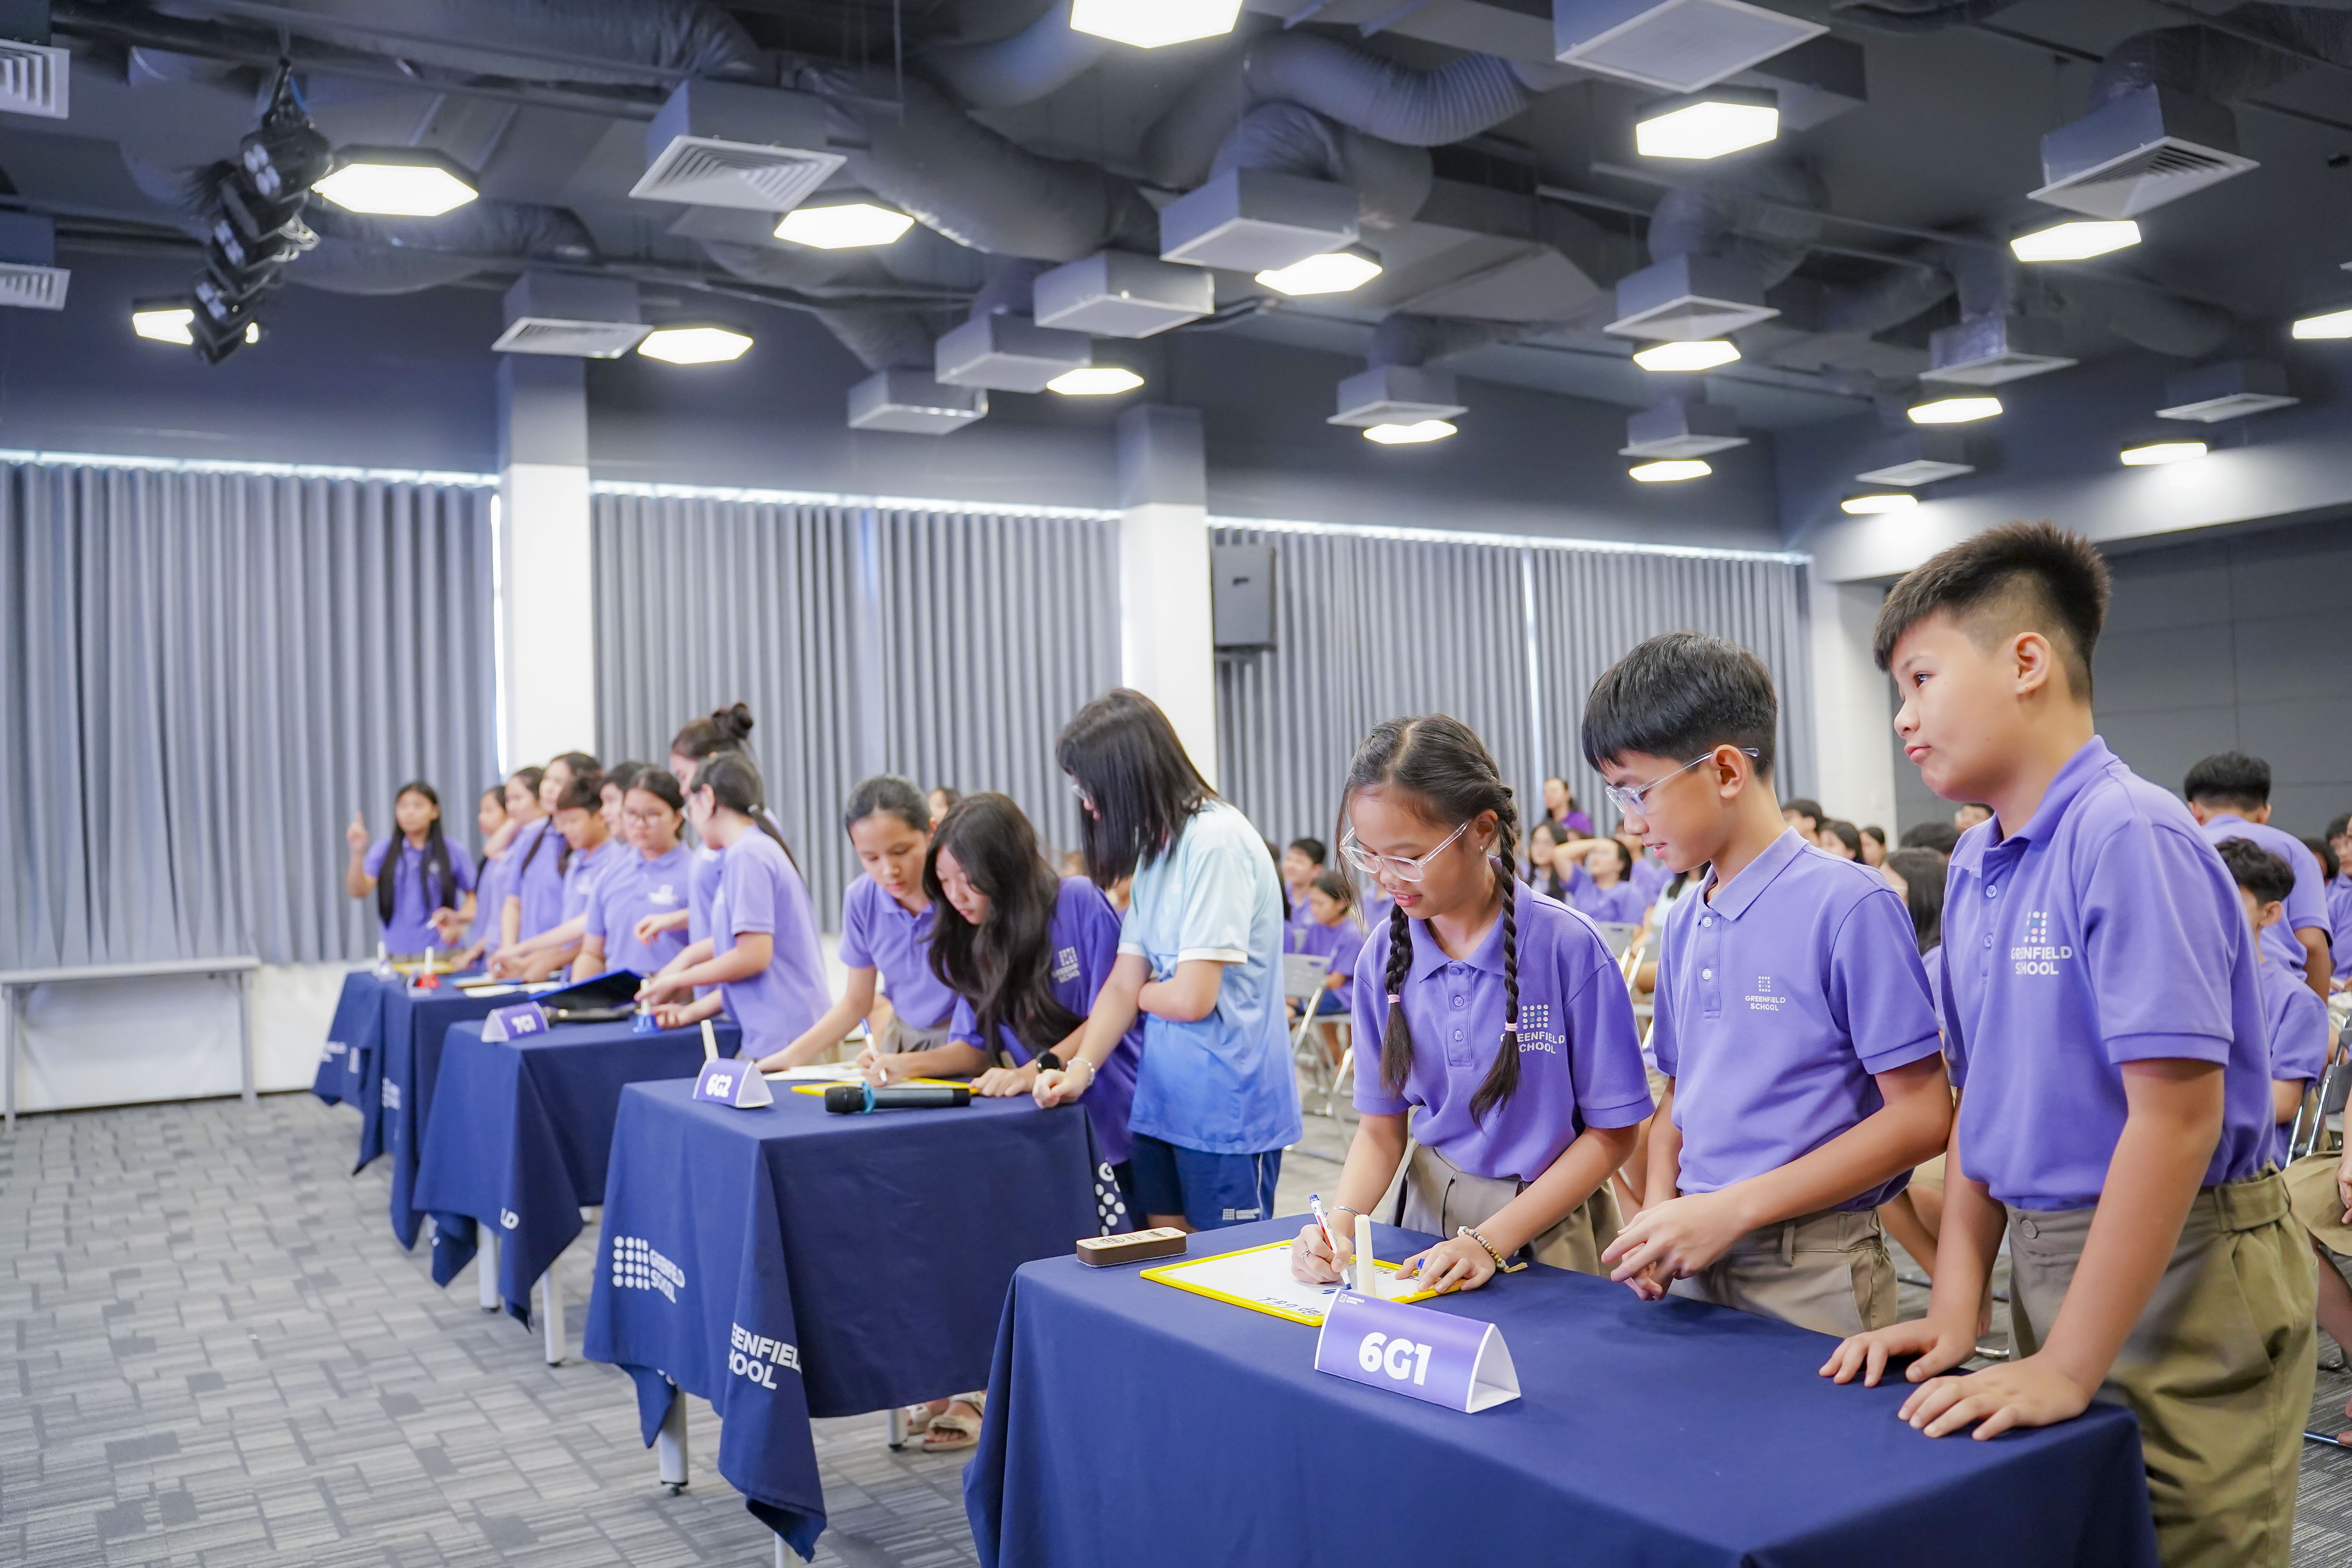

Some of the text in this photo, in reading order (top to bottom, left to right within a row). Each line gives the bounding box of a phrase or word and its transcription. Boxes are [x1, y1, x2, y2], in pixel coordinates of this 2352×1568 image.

[2011, 946, 2073, 960] GRNFIELD
[2015, 961, 2059, 975] SHOOL
[1745, 995, 1786, 1004] GREENFIELD
[1750, 1003, 1779, 1011] SCHOOL
[1500, 1031, 1565, 1044] EENFIELD
[1519, 1042, 1556, 1054] CHOOL
[706, 1073, 732, 1098] 6G2
[1359, 1332, 1432, 1386] 6G1
